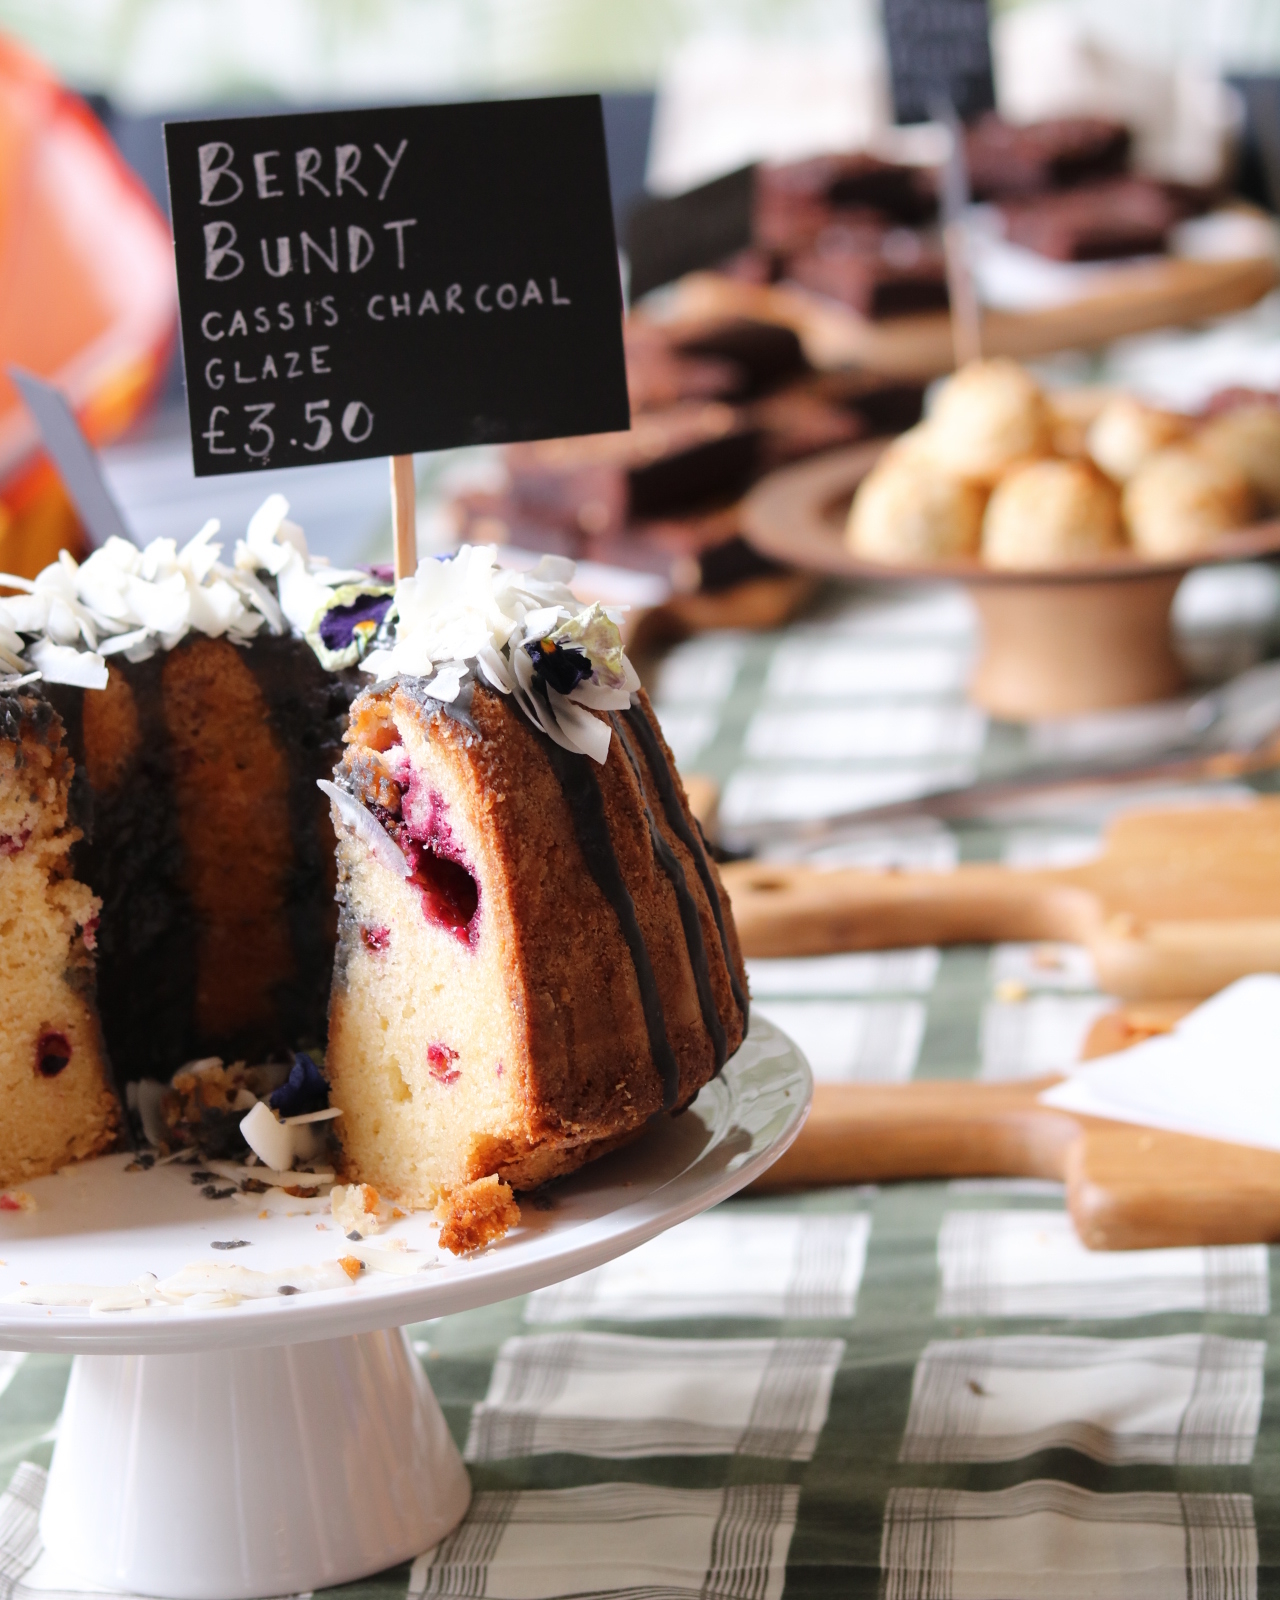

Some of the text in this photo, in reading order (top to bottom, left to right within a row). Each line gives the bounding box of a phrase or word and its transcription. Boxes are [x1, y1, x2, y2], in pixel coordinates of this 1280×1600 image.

[197, 138, 409, 207] BERRY
[203, 218, 418, 281] BUNDT
[201, 277, 571, 341] CASSIS CHARCOAL
[204, 345, 332, 390] GLAZE
[201, 399, 375, 457] £3.50
